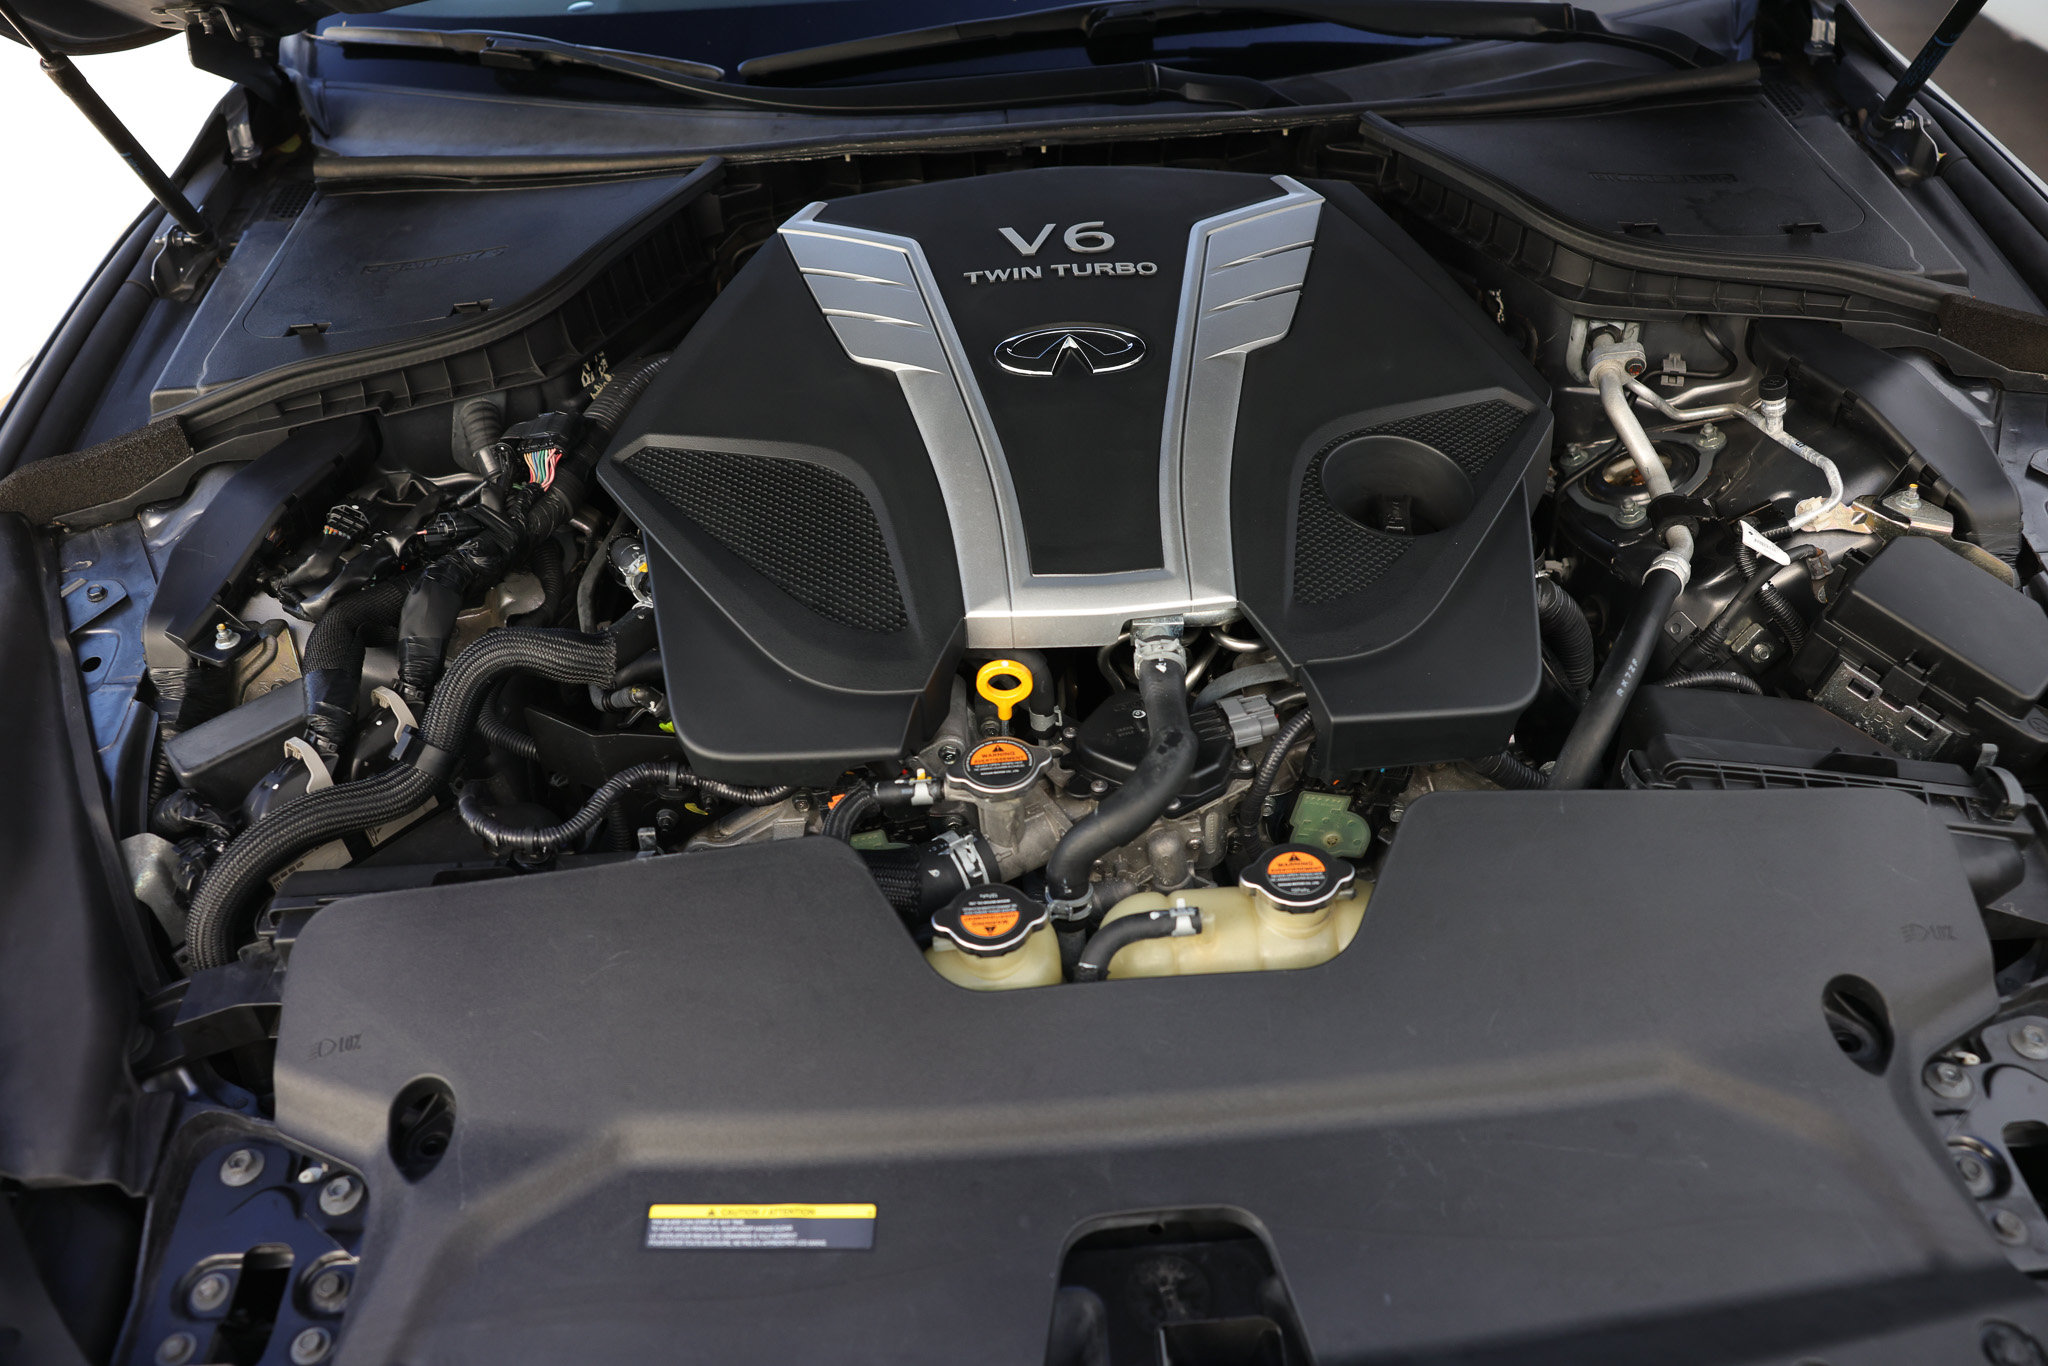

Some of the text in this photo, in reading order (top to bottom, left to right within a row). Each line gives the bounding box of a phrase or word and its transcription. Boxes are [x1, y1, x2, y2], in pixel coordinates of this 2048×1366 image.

[998, 221, 1115, 257] V6
[963, 262, 1158, 285] TWIN TURBO
